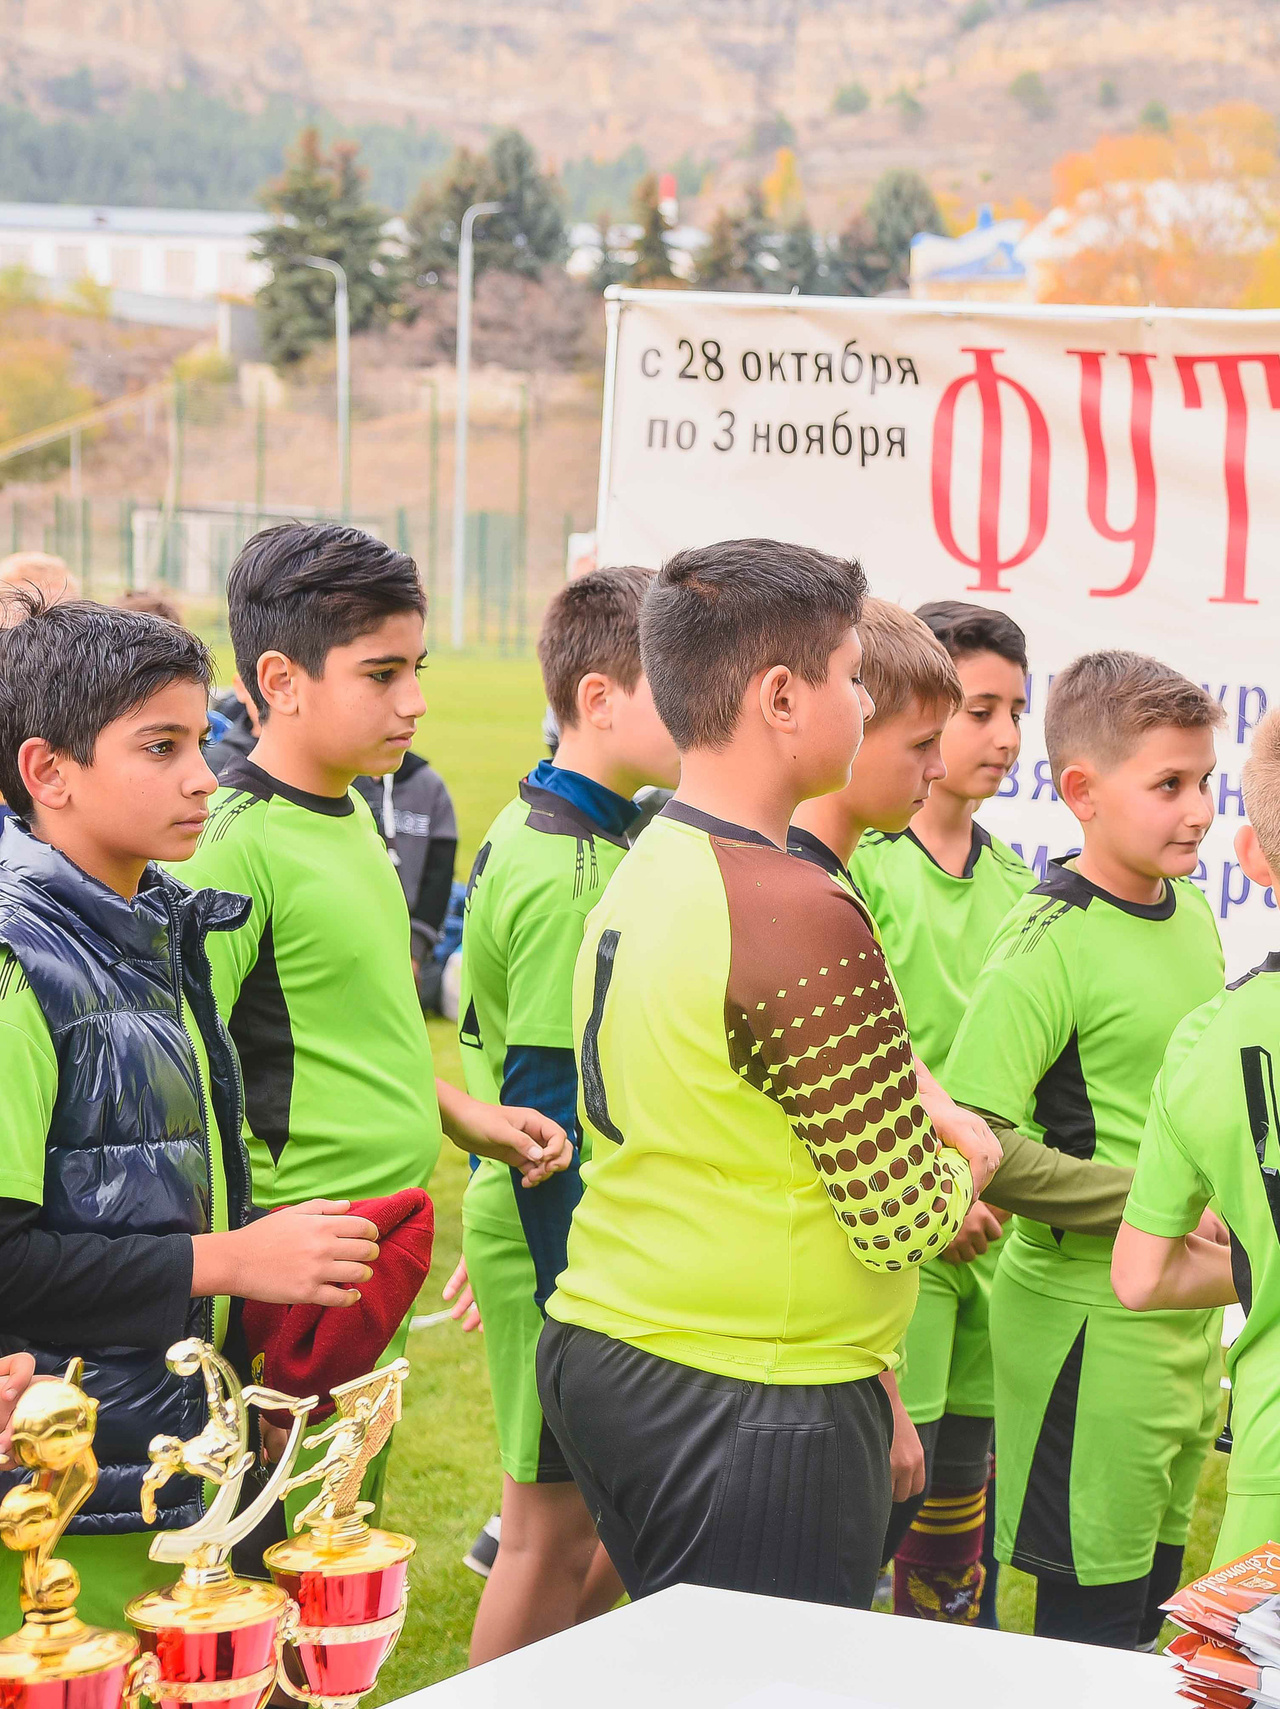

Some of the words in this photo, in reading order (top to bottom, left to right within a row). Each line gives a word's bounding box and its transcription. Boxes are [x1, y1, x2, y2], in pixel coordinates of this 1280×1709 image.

[640, 343, 662, 379] с
[677, 338, 725, 383] 28
[740, 338, 920, 395] октября
[646, 415, 697, 451] по
[712, 410, 736, 452] 3
[751, 409, 907, 468] ноября
